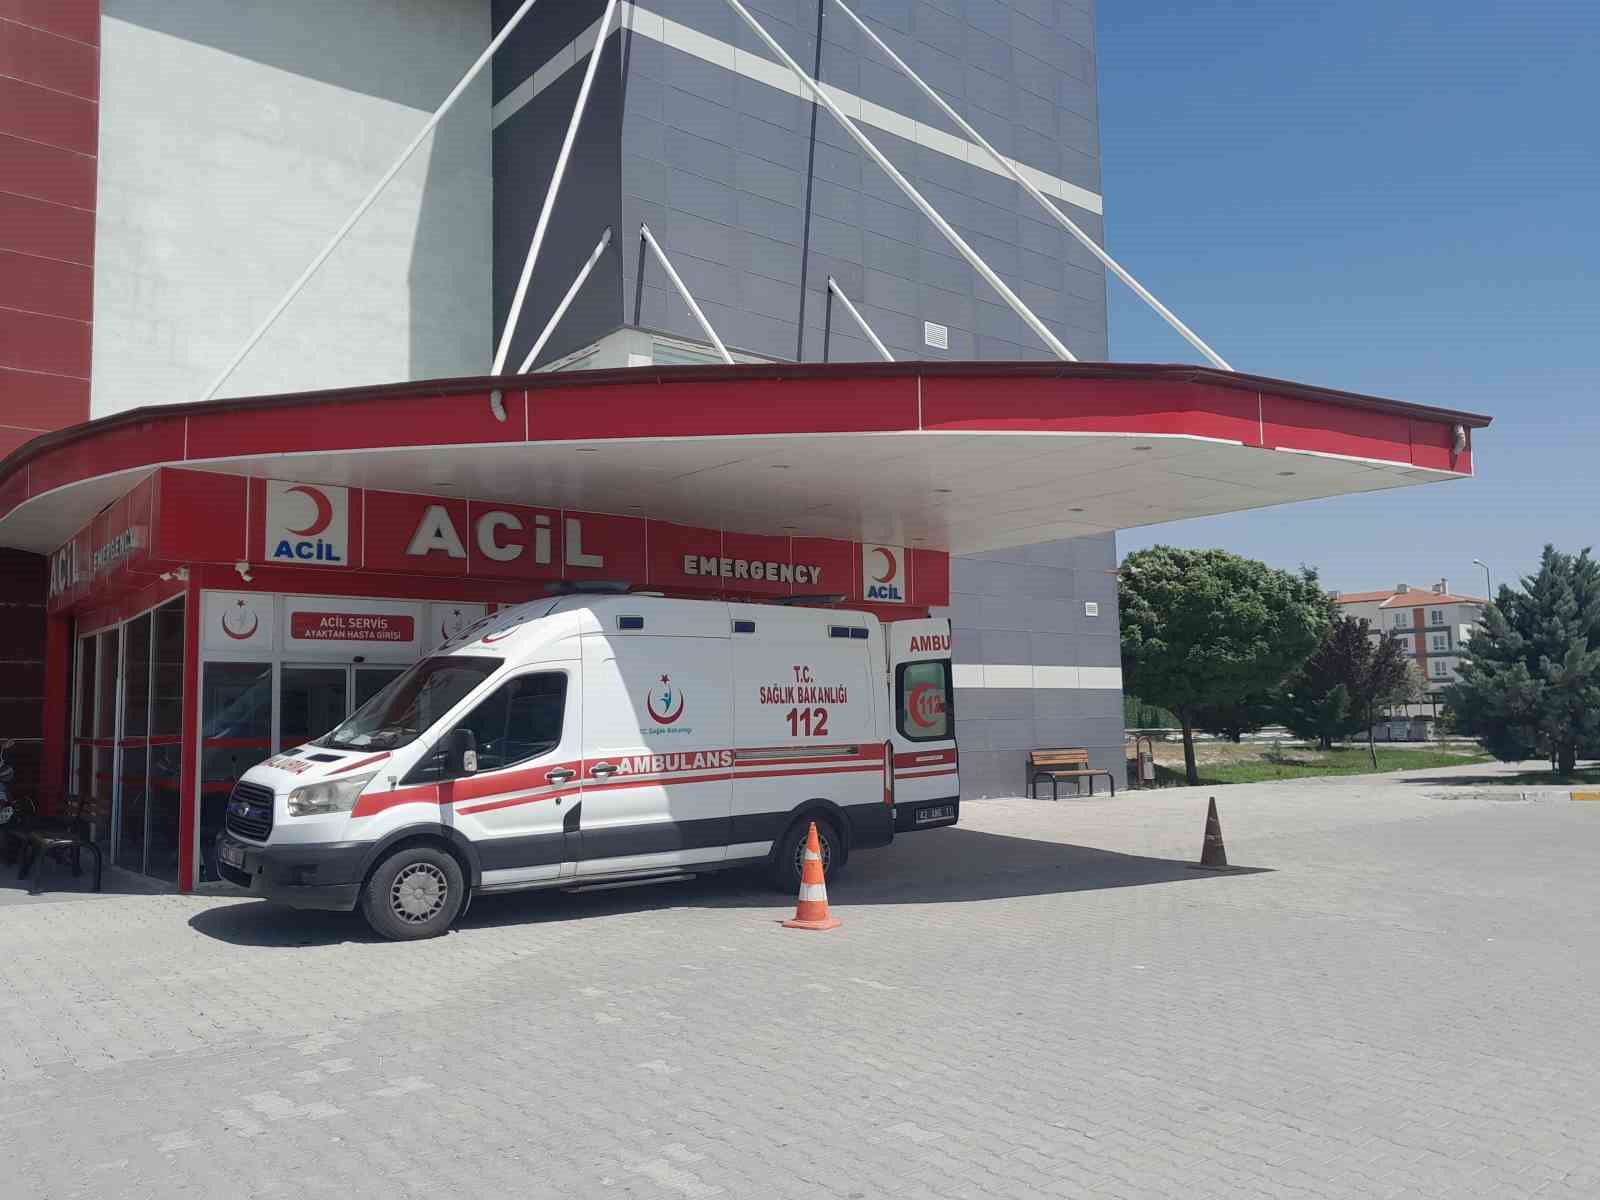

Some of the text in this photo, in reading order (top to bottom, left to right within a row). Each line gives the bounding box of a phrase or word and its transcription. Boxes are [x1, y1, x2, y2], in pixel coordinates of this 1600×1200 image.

[273, 538, 341, 561] ACİL
[683, 554, 823, 585] EMERGENCY
[320, 616, 346, 628] ACİL
[304, 629, 345, 639] AYAKTAN
[347, 630, 375, 640] HASTA
[910, 635, 950, 652] AMBU
[793, 665, 814, 683] T.C.
[760, 683, 847, 704] SAĞLIK BAKANLIĞI
[786, 707, 828, 736] 112
[617, 750, 732, 774] AMBULANS
